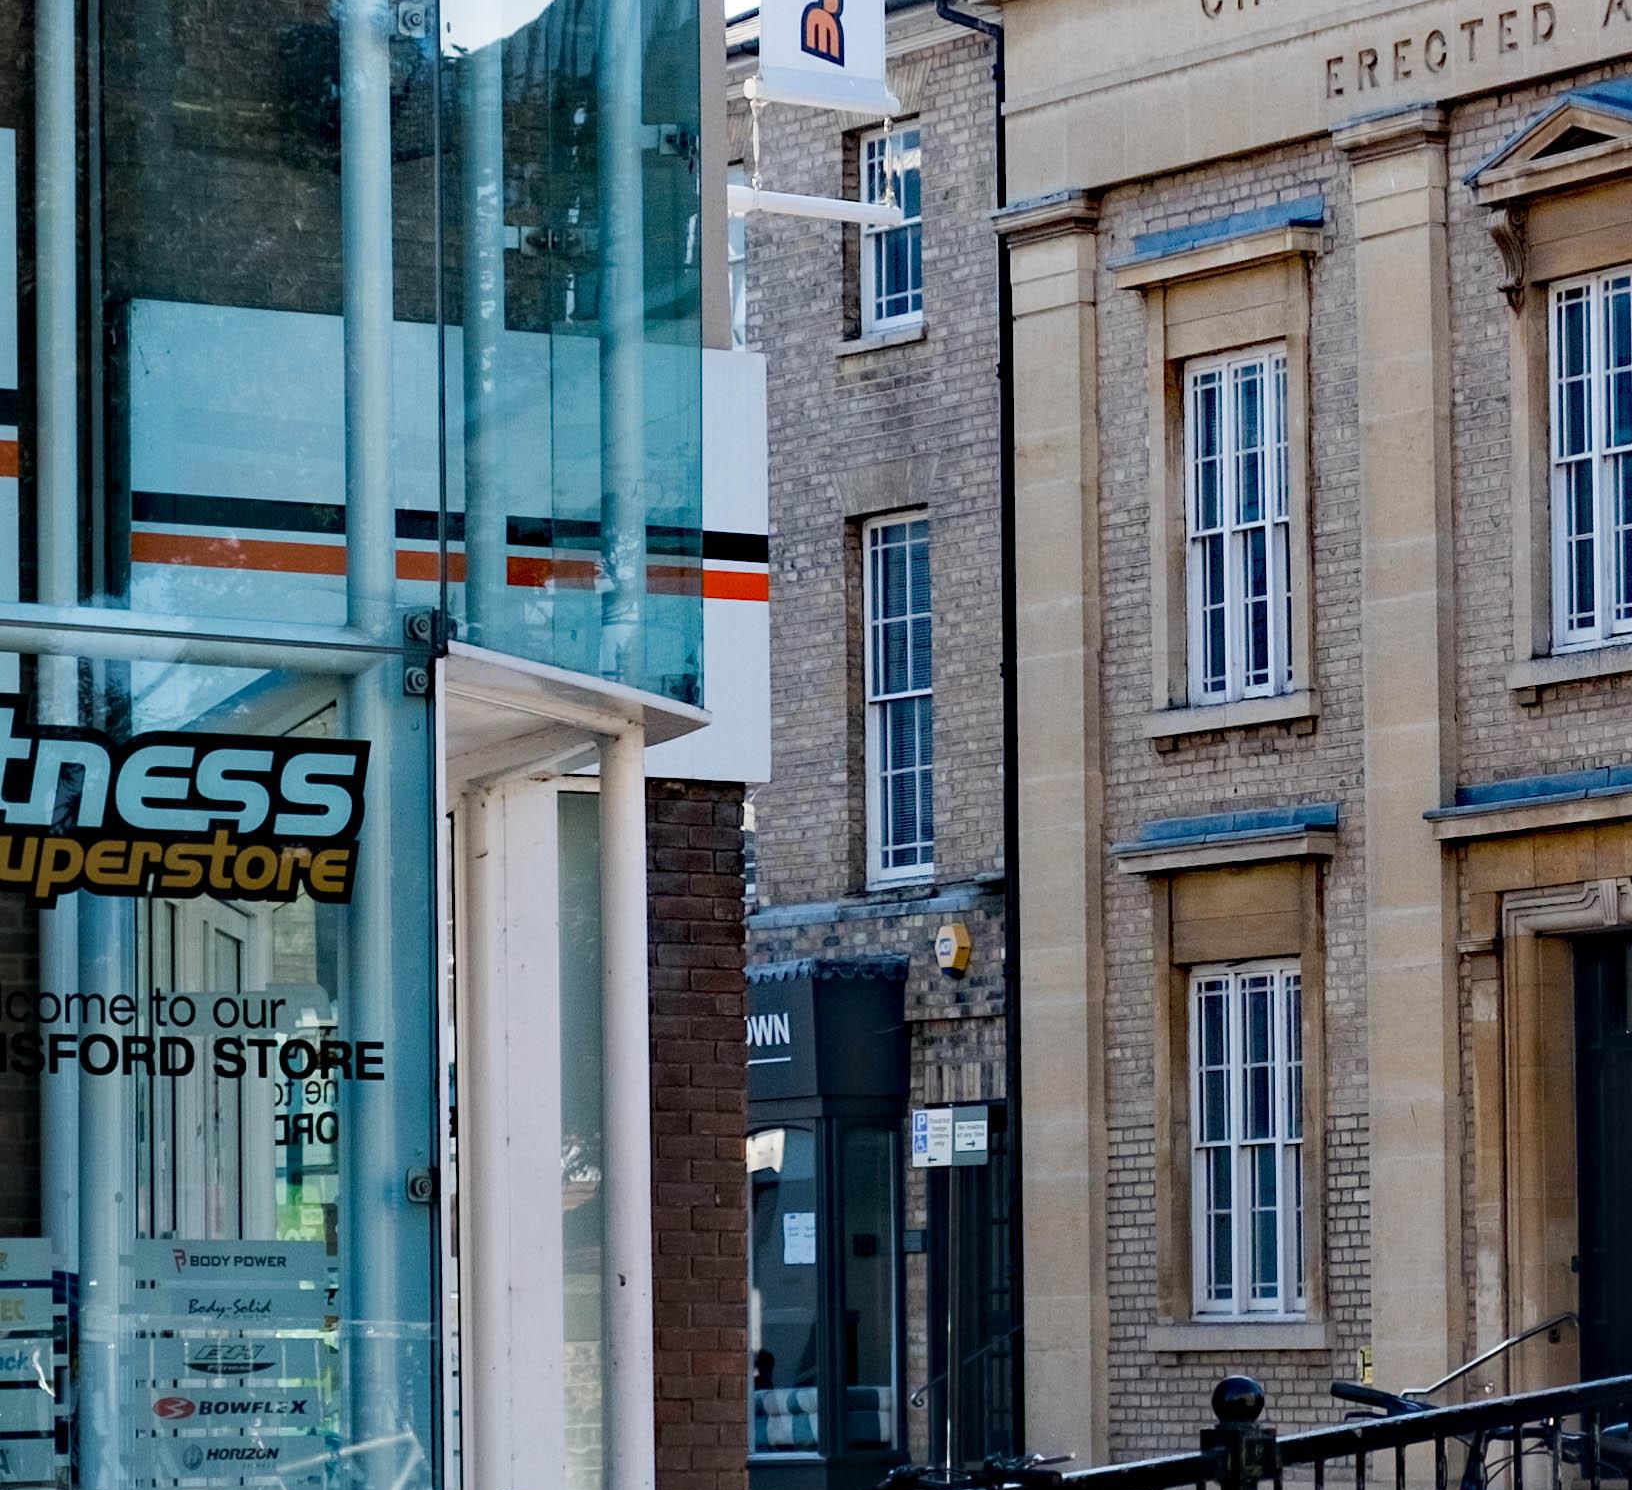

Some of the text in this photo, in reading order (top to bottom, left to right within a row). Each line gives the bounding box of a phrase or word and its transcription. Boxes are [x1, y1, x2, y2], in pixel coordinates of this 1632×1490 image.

[1324, 1, 1558, 100] ERECTED
[0, 987, 286, 1030] come to our
[212, 1036, 385, 1081] STORE
[190, 1255, 287, 1268] BODY POWER
[188, 1298, 272, 1319] Body-Solid
[198, 1399, 308, 1416] BOWFLEX
[206, 1447, 280, 1461] HORIZON
